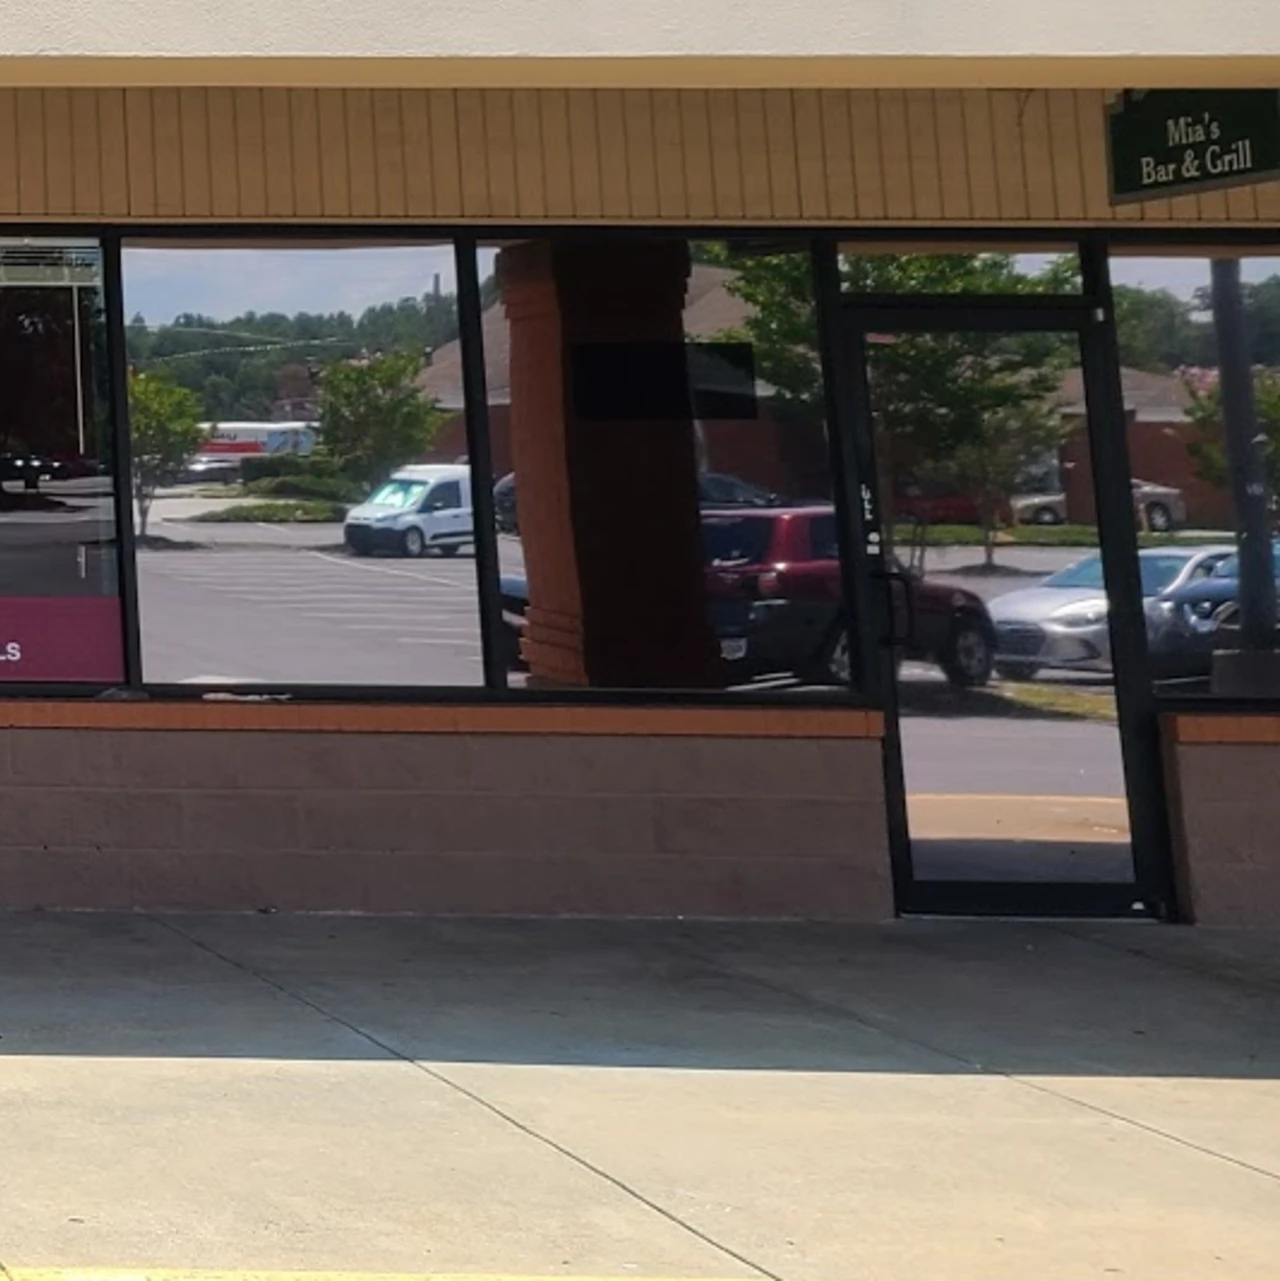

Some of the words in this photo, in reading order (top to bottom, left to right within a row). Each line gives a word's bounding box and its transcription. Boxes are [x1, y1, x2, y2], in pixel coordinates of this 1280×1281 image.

[1166, 112, 1221, 147] Mia's
[1140, 156, 1176, 185] Bar
[1181, 149, 1201, 178] &
[1205, 138, 1253, 174] Grill
